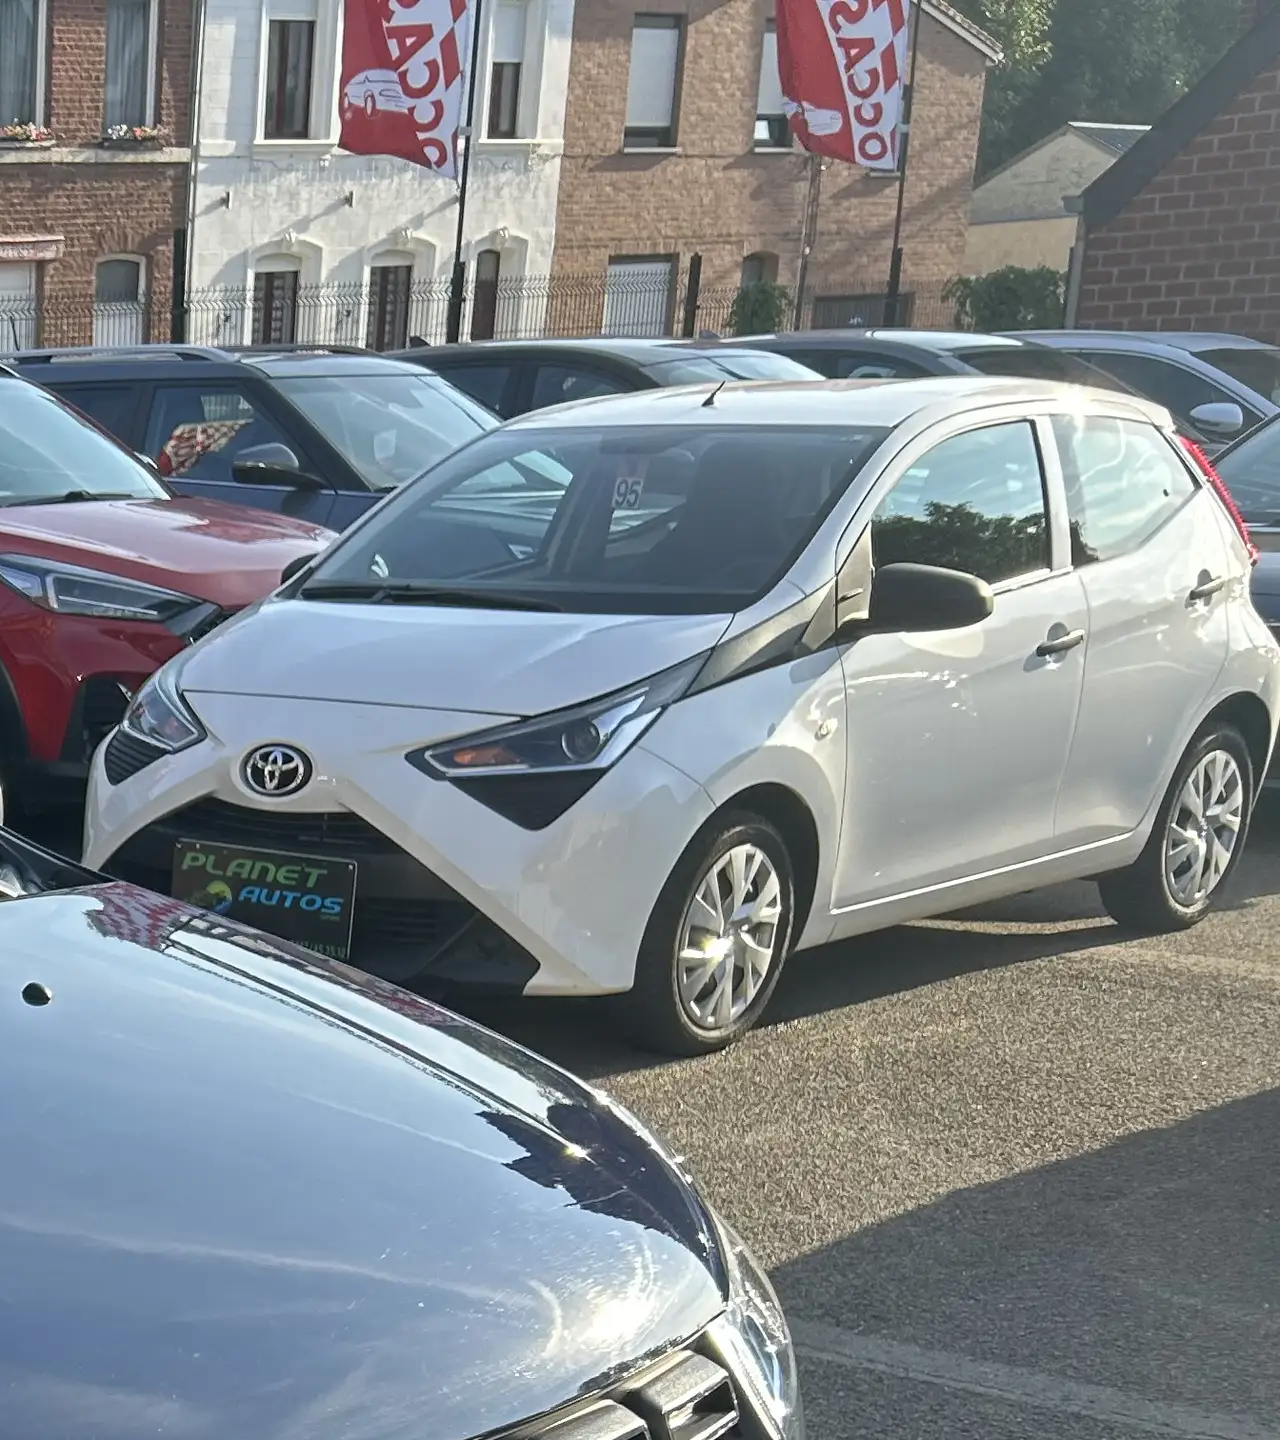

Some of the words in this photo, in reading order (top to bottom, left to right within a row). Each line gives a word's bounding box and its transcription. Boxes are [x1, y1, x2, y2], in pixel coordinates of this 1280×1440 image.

[615, 478, 642, 507] 95
[180, 851, 328, 888] PLANET
[238, 885, 345, 914] AUTOS
